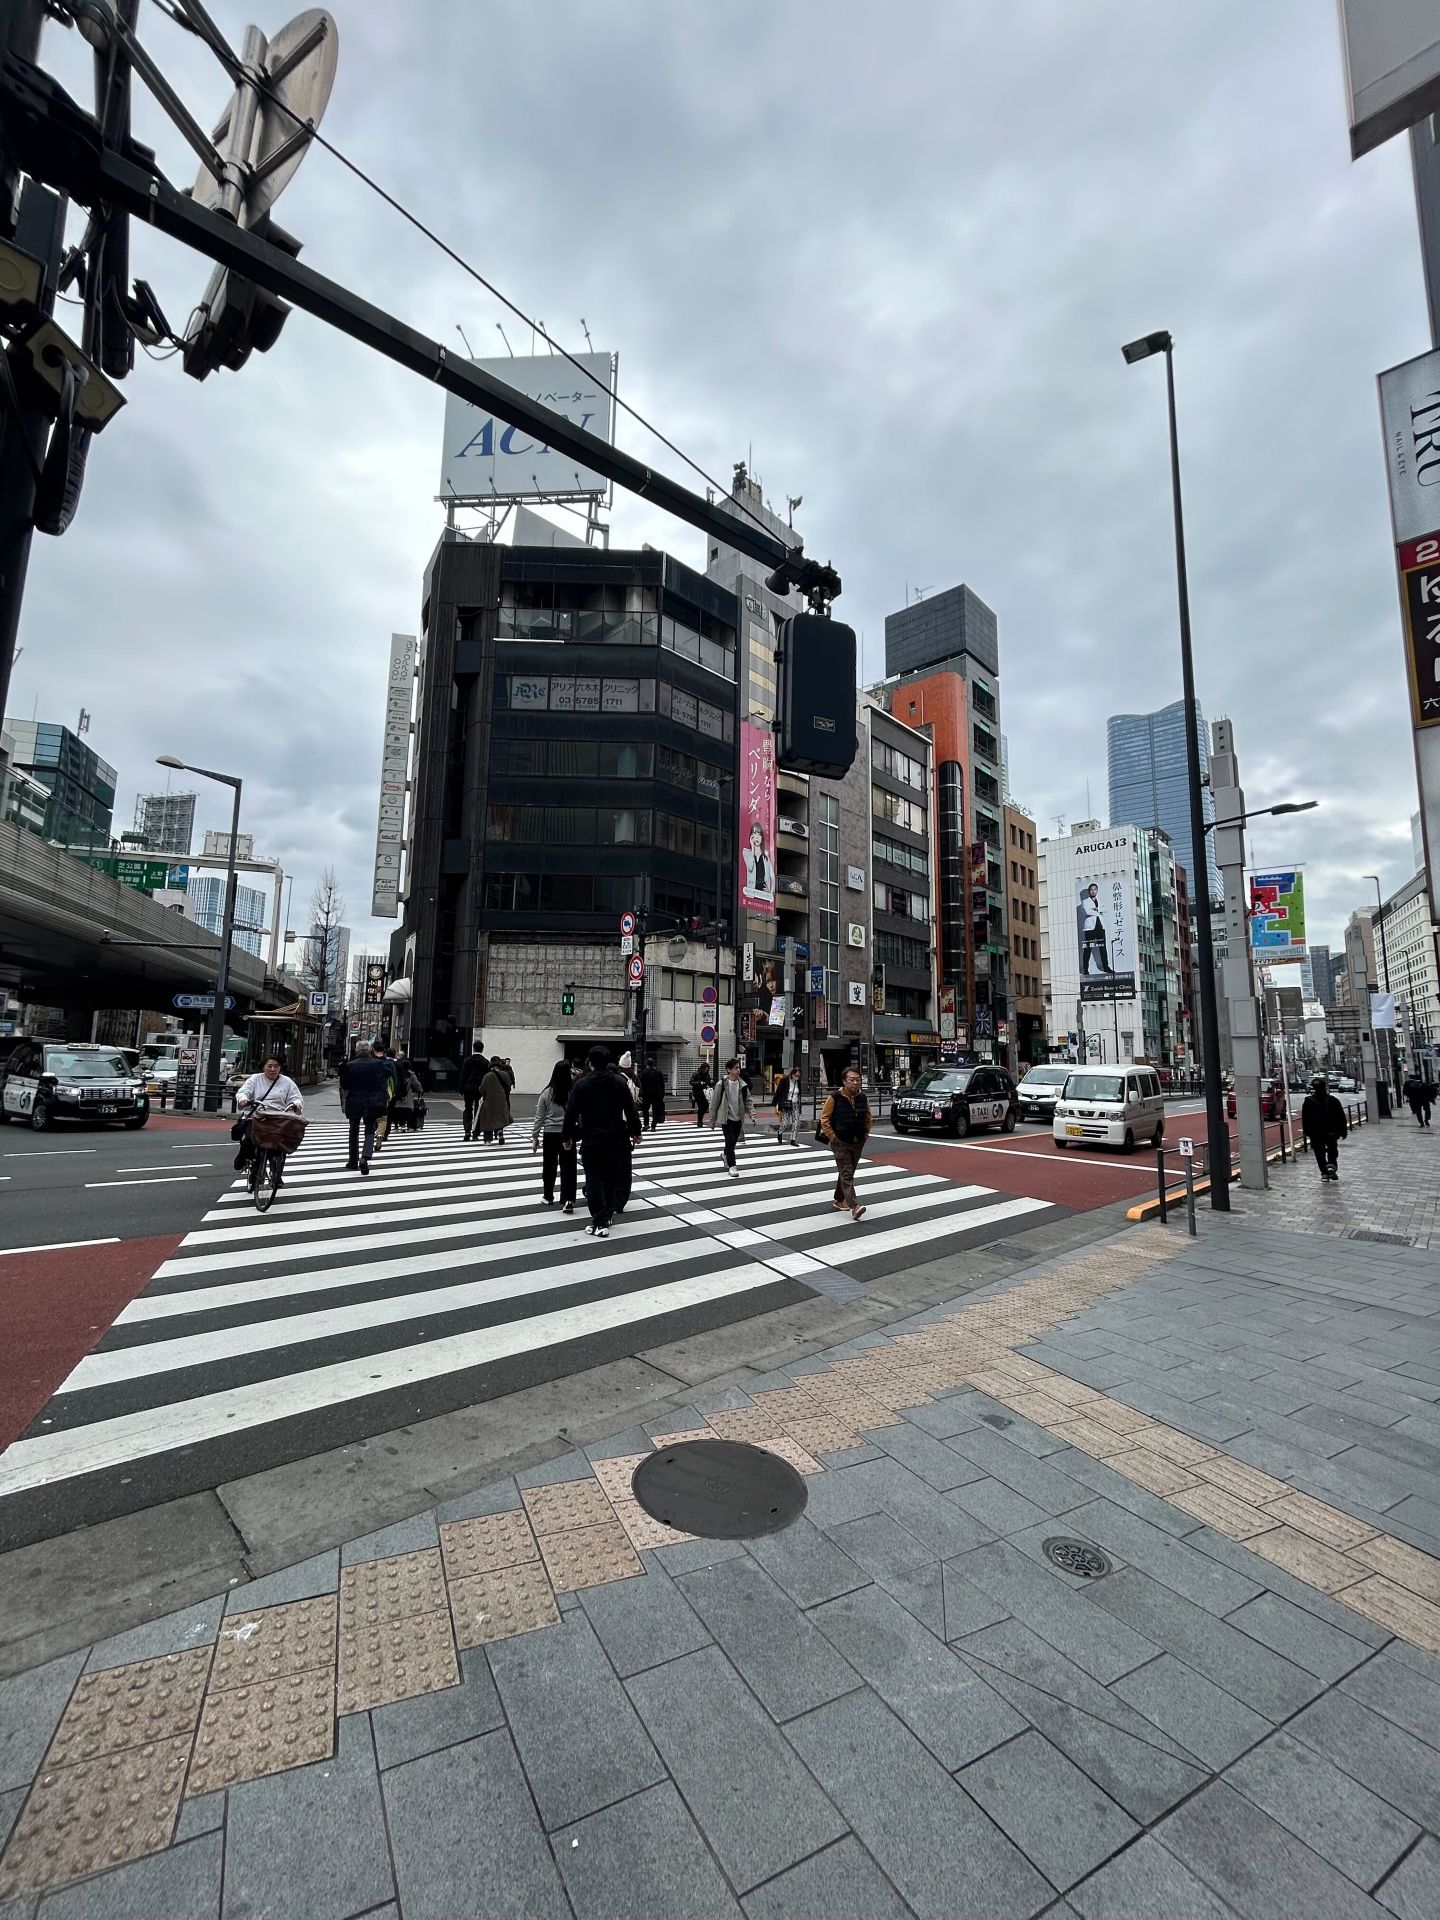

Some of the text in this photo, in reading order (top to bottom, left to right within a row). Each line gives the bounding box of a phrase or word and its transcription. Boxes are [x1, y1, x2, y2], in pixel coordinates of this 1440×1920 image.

[1395, 431, 1404, 452] NAIL
[1398, 460, 1408, 476] EYE
[391, 657, 402, 681] COCO
[399, 640, 414, 682] ROPPONGI
[551, 682, 639, 695] アリア六本木クリニック
[762, 738, 773, 801] 豊胸なら
[748, 747, 761, 819] ベリンダ。
[1075, 837, 1127, 855] ARUGA 13
[977, 1107, 989, 1117] TAXI
